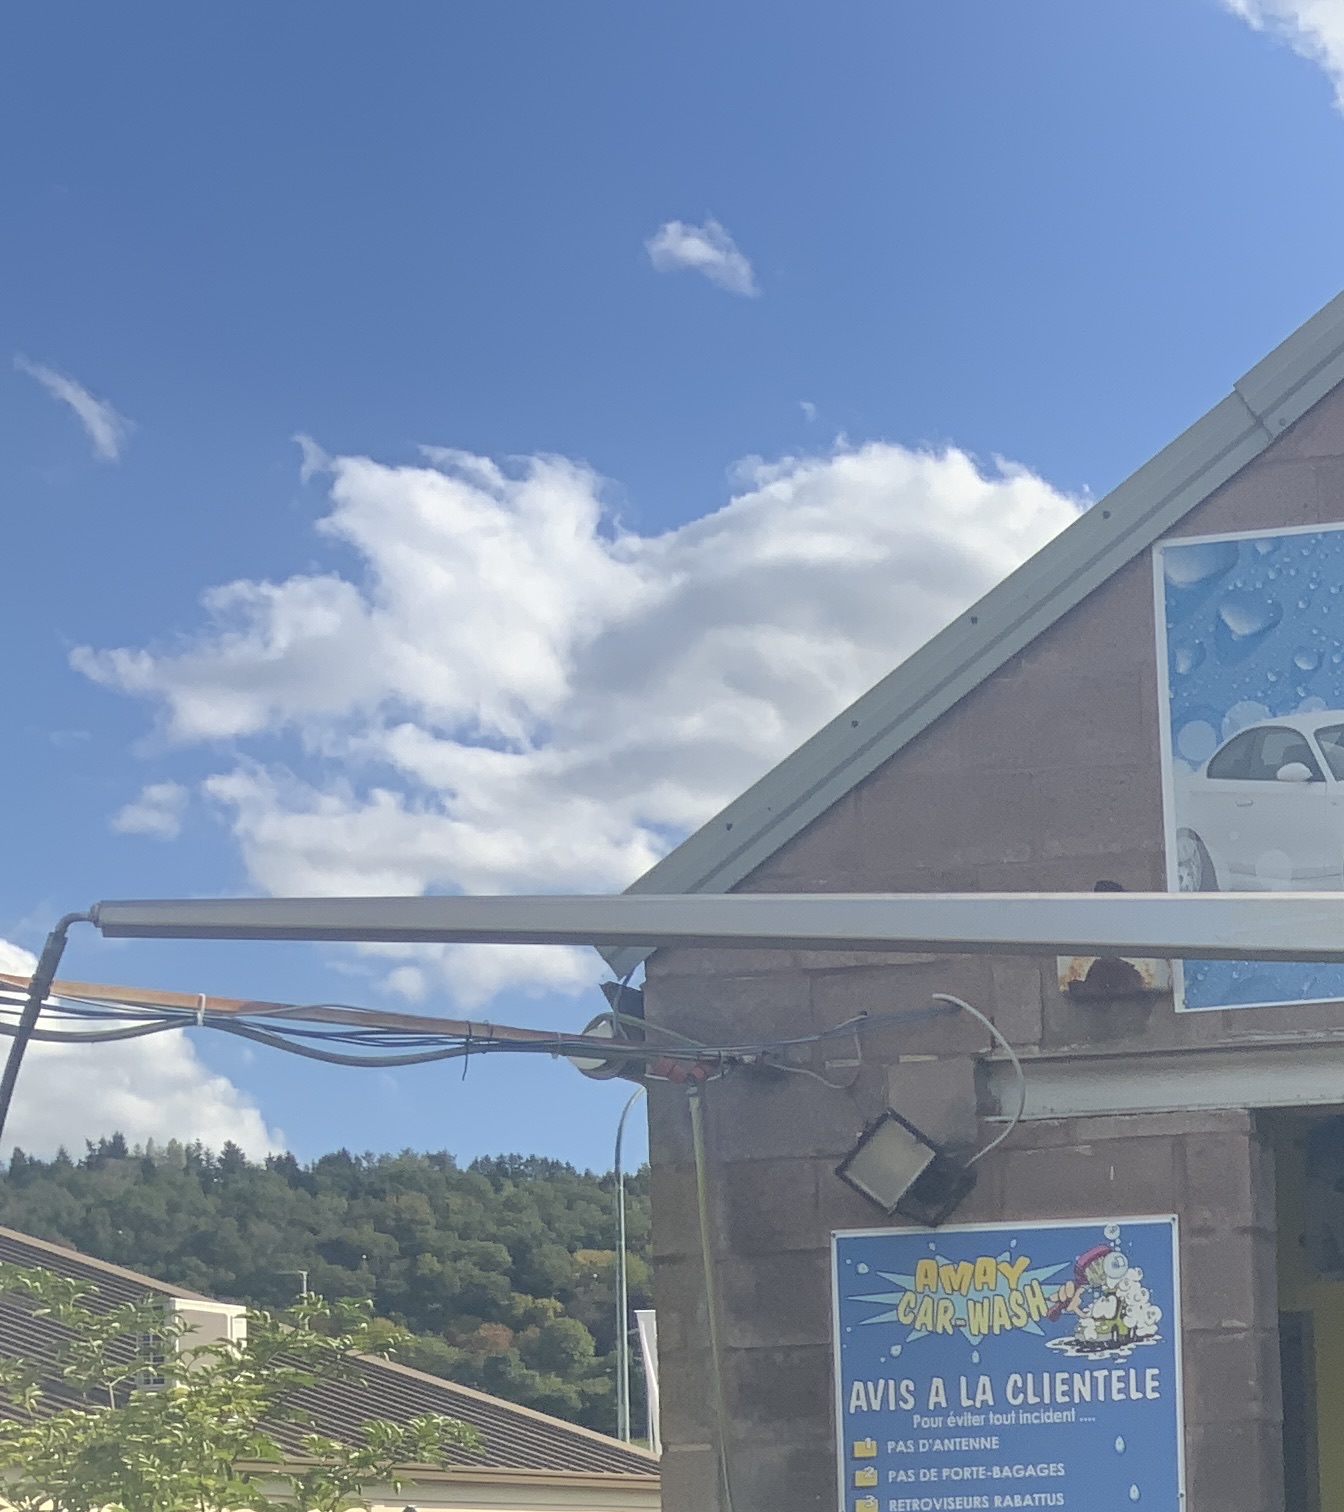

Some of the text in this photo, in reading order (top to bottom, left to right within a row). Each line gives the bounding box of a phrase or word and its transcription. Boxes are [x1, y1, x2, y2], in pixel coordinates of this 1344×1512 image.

[914, 1256, 1030, 1295] AMAY
[897, 1280, 1048, 1336] CAR-WASH
[850, 1368, 1160, 1414] AVIS A LA CLIENTELE
[913, 1409, 1075, 1430] Pour éviter tout incident
[888, 1437, 999, 1454] PAS D'ANTENNE
[889, 1463, 1065, 1483] PAS DE PORTE-BAGAGES
[889, 1493, 1064, 1512] RETROVISEURS RABATTUS
